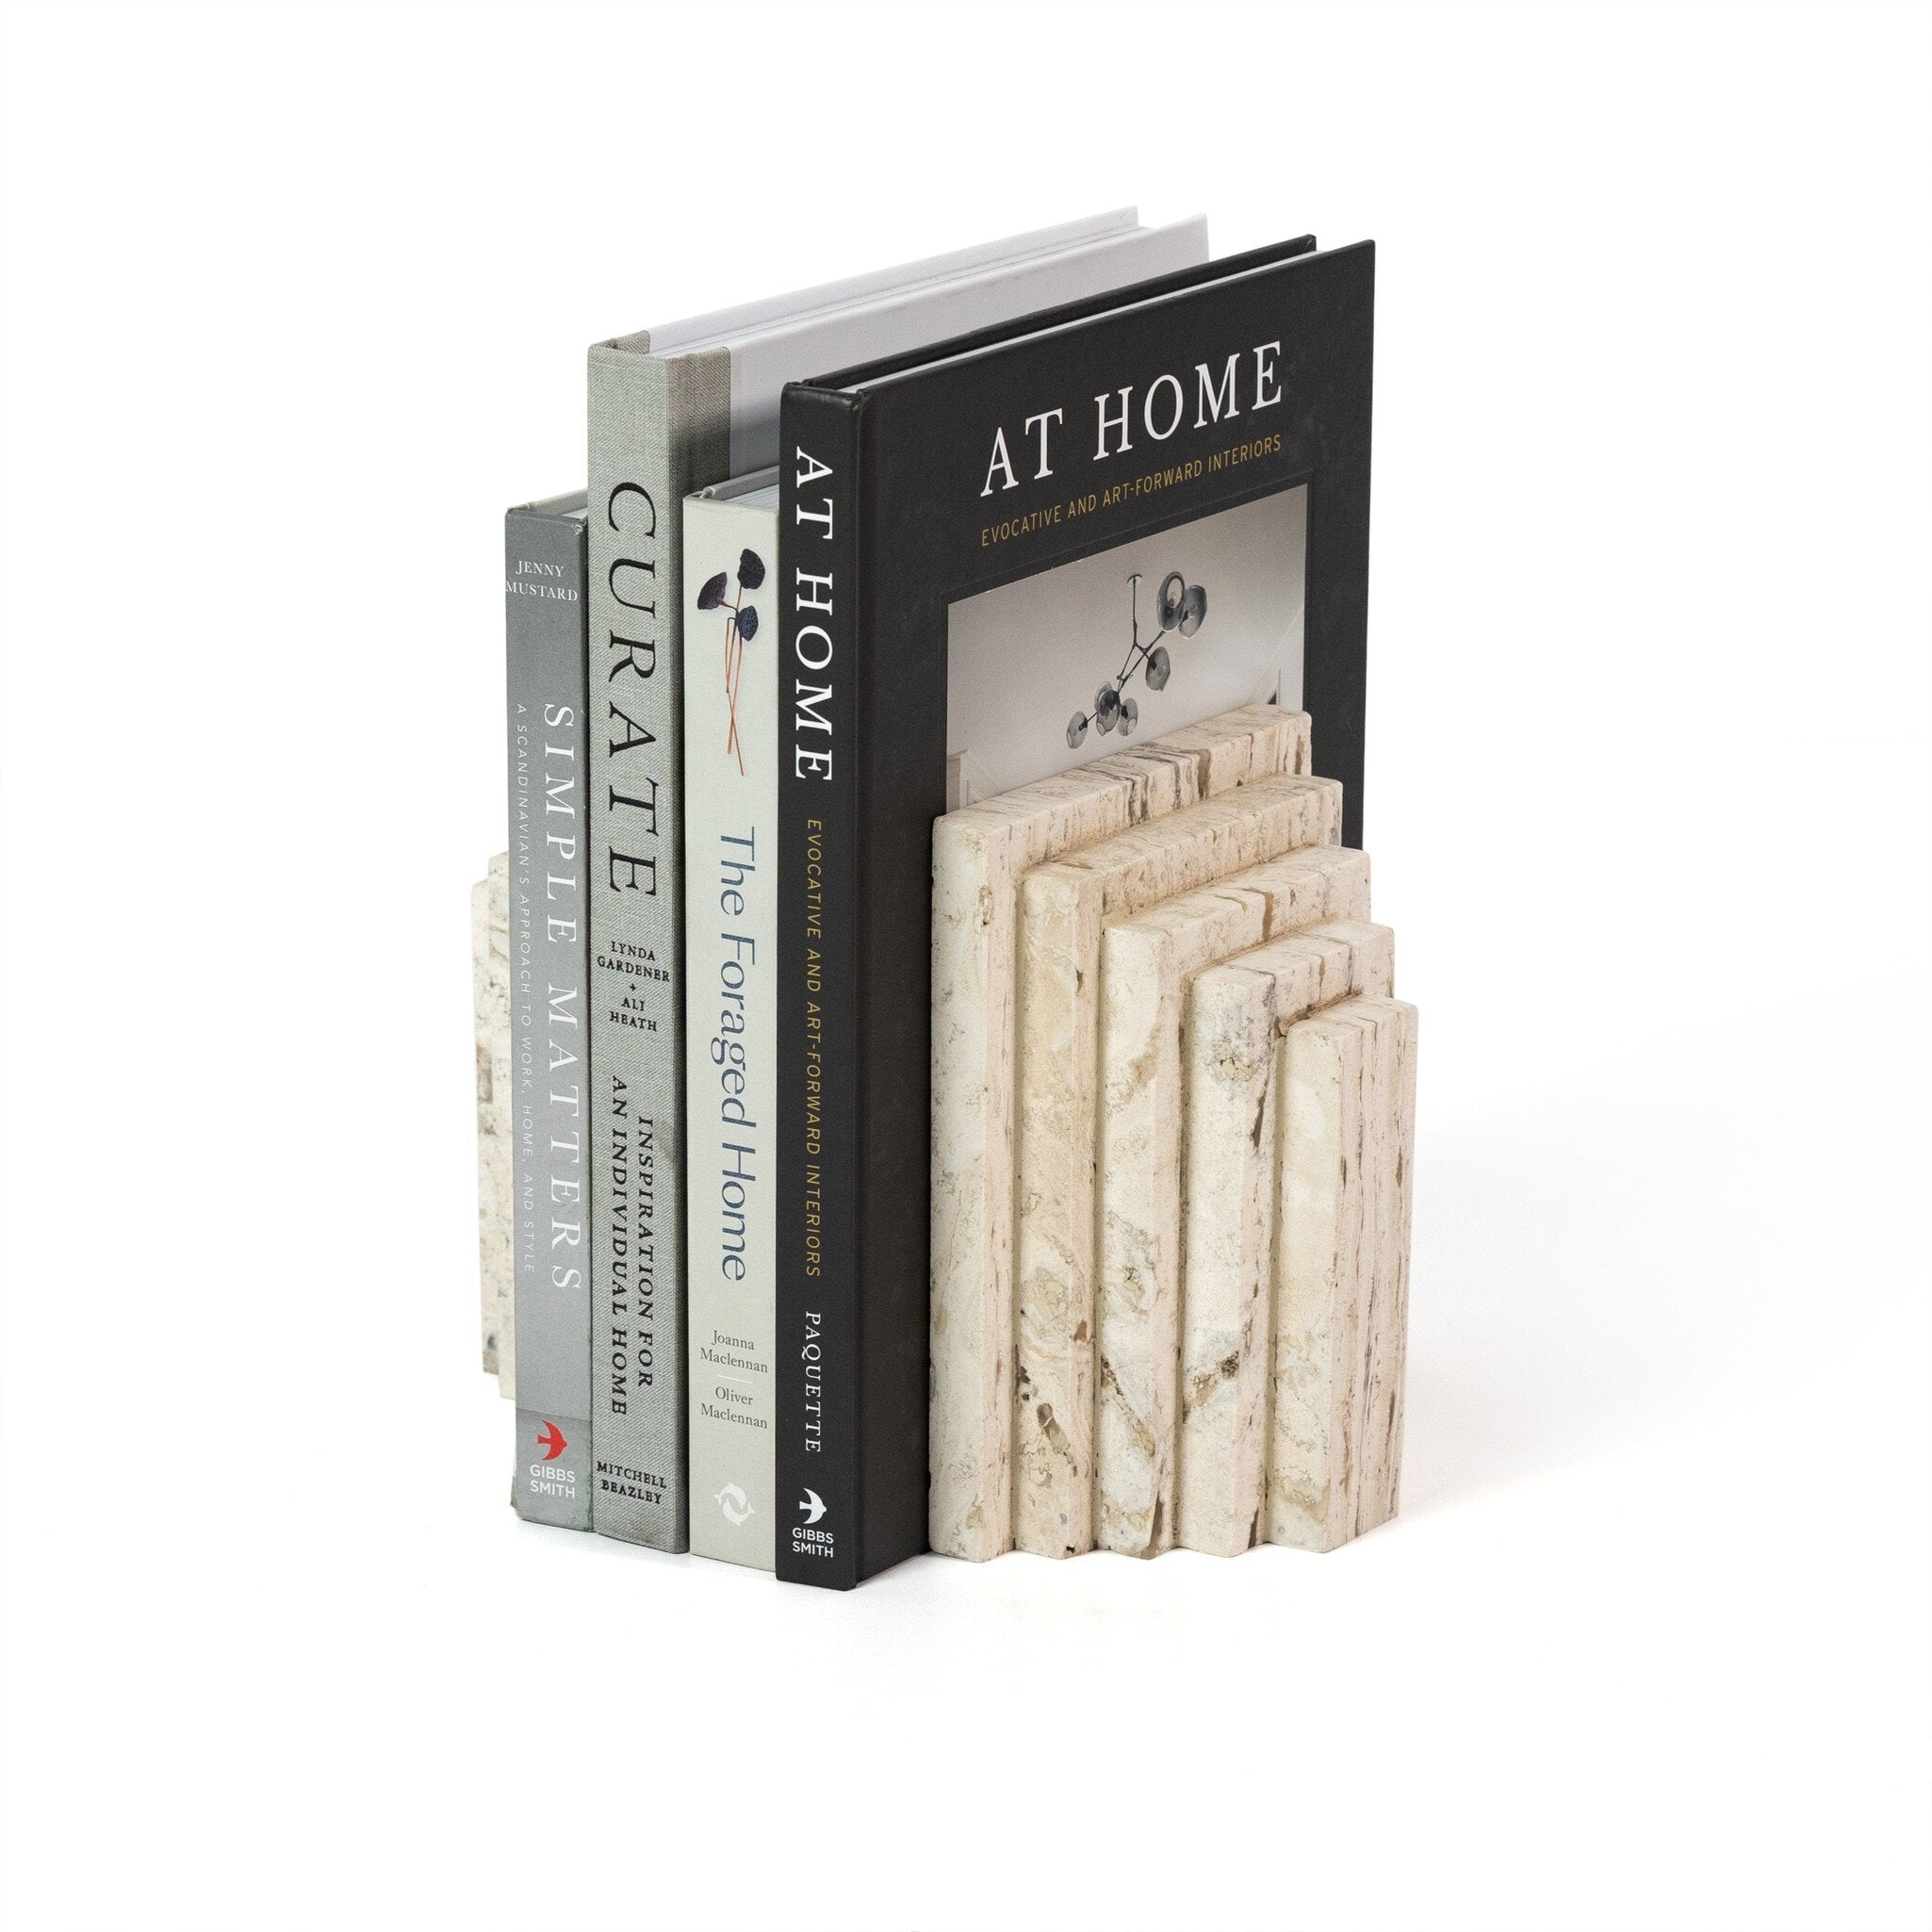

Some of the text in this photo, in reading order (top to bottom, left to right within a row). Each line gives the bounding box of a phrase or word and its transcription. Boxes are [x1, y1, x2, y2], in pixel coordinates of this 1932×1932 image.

[980, 340, 1282, 498] AT HOME
[981, 434, 1282, 548] EVOCATIVE AND ART-FORWARD INTERIORS
[516, 560, 565, 578] JENNY
[505, 581, 579, 601] MUSTARD
[795, 446, 833, 780] AT HOME
[608, 482, 659, 896] CURATE
[611, 941, 656, 962] LYNDA
[597, 956, 670, 982] GARDENER
[516, 703, 535, 1273] A SCANDINAVIAN'S APPROACH TO WORK, HOME, AND STYLE
[544, 703, 582, 1288] SIMPLE MATTERS
[621, 997, 645, 1011] ALI
[610, 1010, 657, 1032] HEATH
[711, 827, 757, 1282] The Foraged Home
[806, 819, 822, 1277] EVOCATIVE AND ART-FORWARD INTERIORS
[612, 1075, 628, 1416] AN INDIVIDUAL HOME
[637, 1116, 654, 1387] INSPIRATION FOR
[712, 1330, 755, 1351] Joanna
[700, 1347, 768, 1373] Maclennan
[801, 1311, 821, 1452] PAQUETTE
[715, 1386, 754, 1405] Oliver
[700, 1403, 768, 1429] Maclennan
[530, 1464, 576, 1483] GIBBS
[596, 1460, 667, 1489] MITCHELL
[530, 1481, 576, 1499] SMITH
[600, 1479, 663, 1505] BEAZLEY
[792, 1527, 834, 1545] GIBBS
[792, 1540, 834, 1558] SMITH
